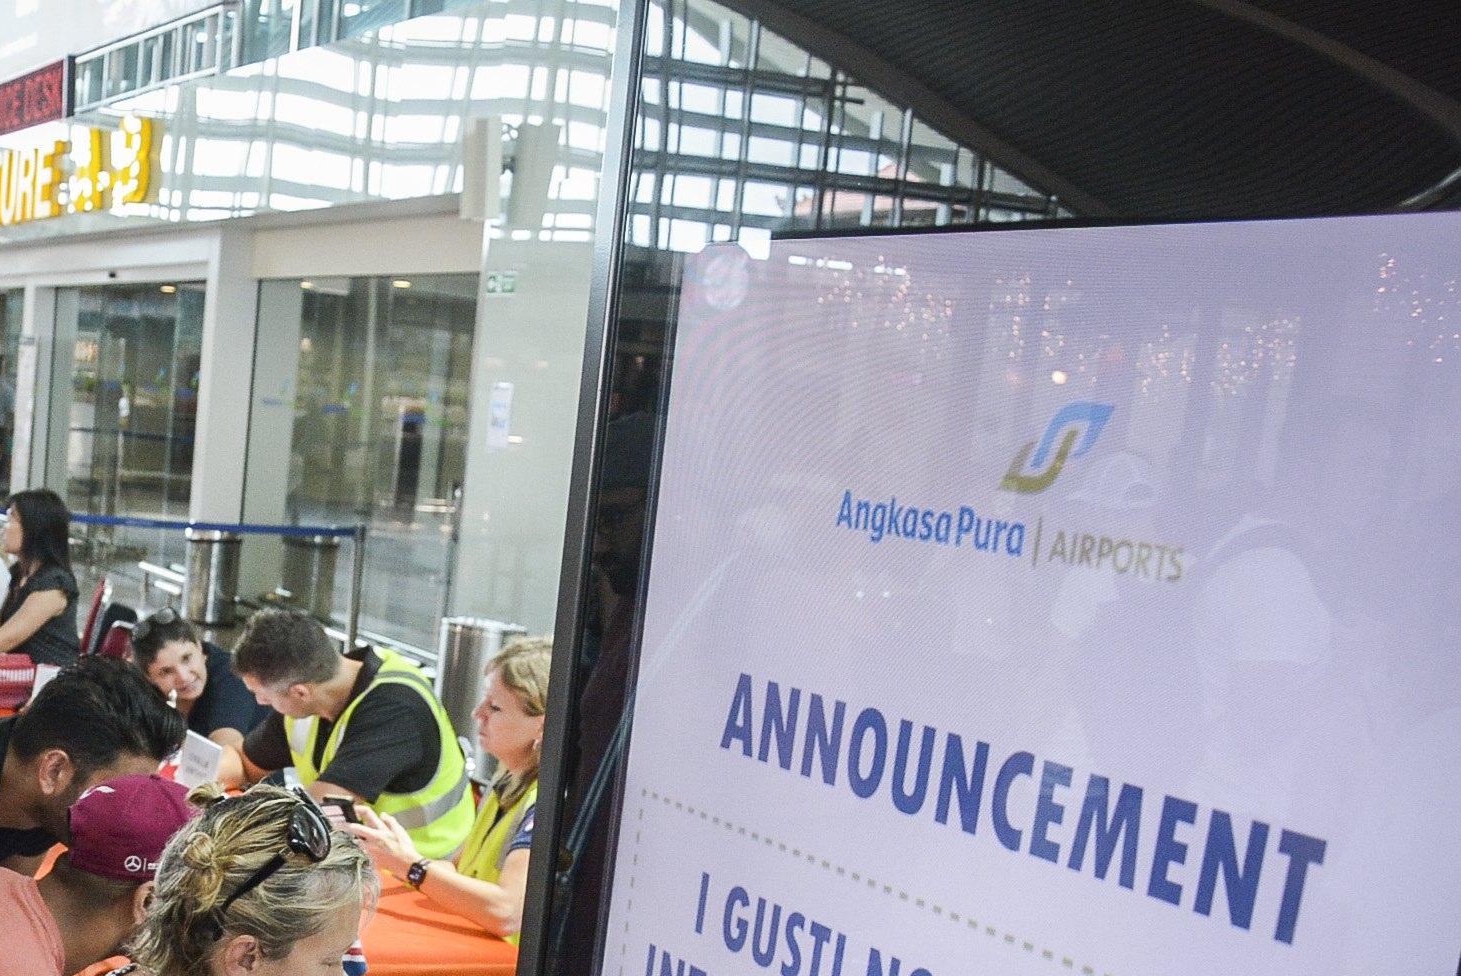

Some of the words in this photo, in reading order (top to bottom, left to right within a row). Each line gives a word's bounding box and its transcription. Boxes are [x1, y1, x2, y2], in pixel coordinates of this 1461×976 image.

[1049, 530, 1184, 582] AIRPORTS
[720, 672, 1328, 946] ANNOUNCEMENT
[694, 872, 710, 935] I
